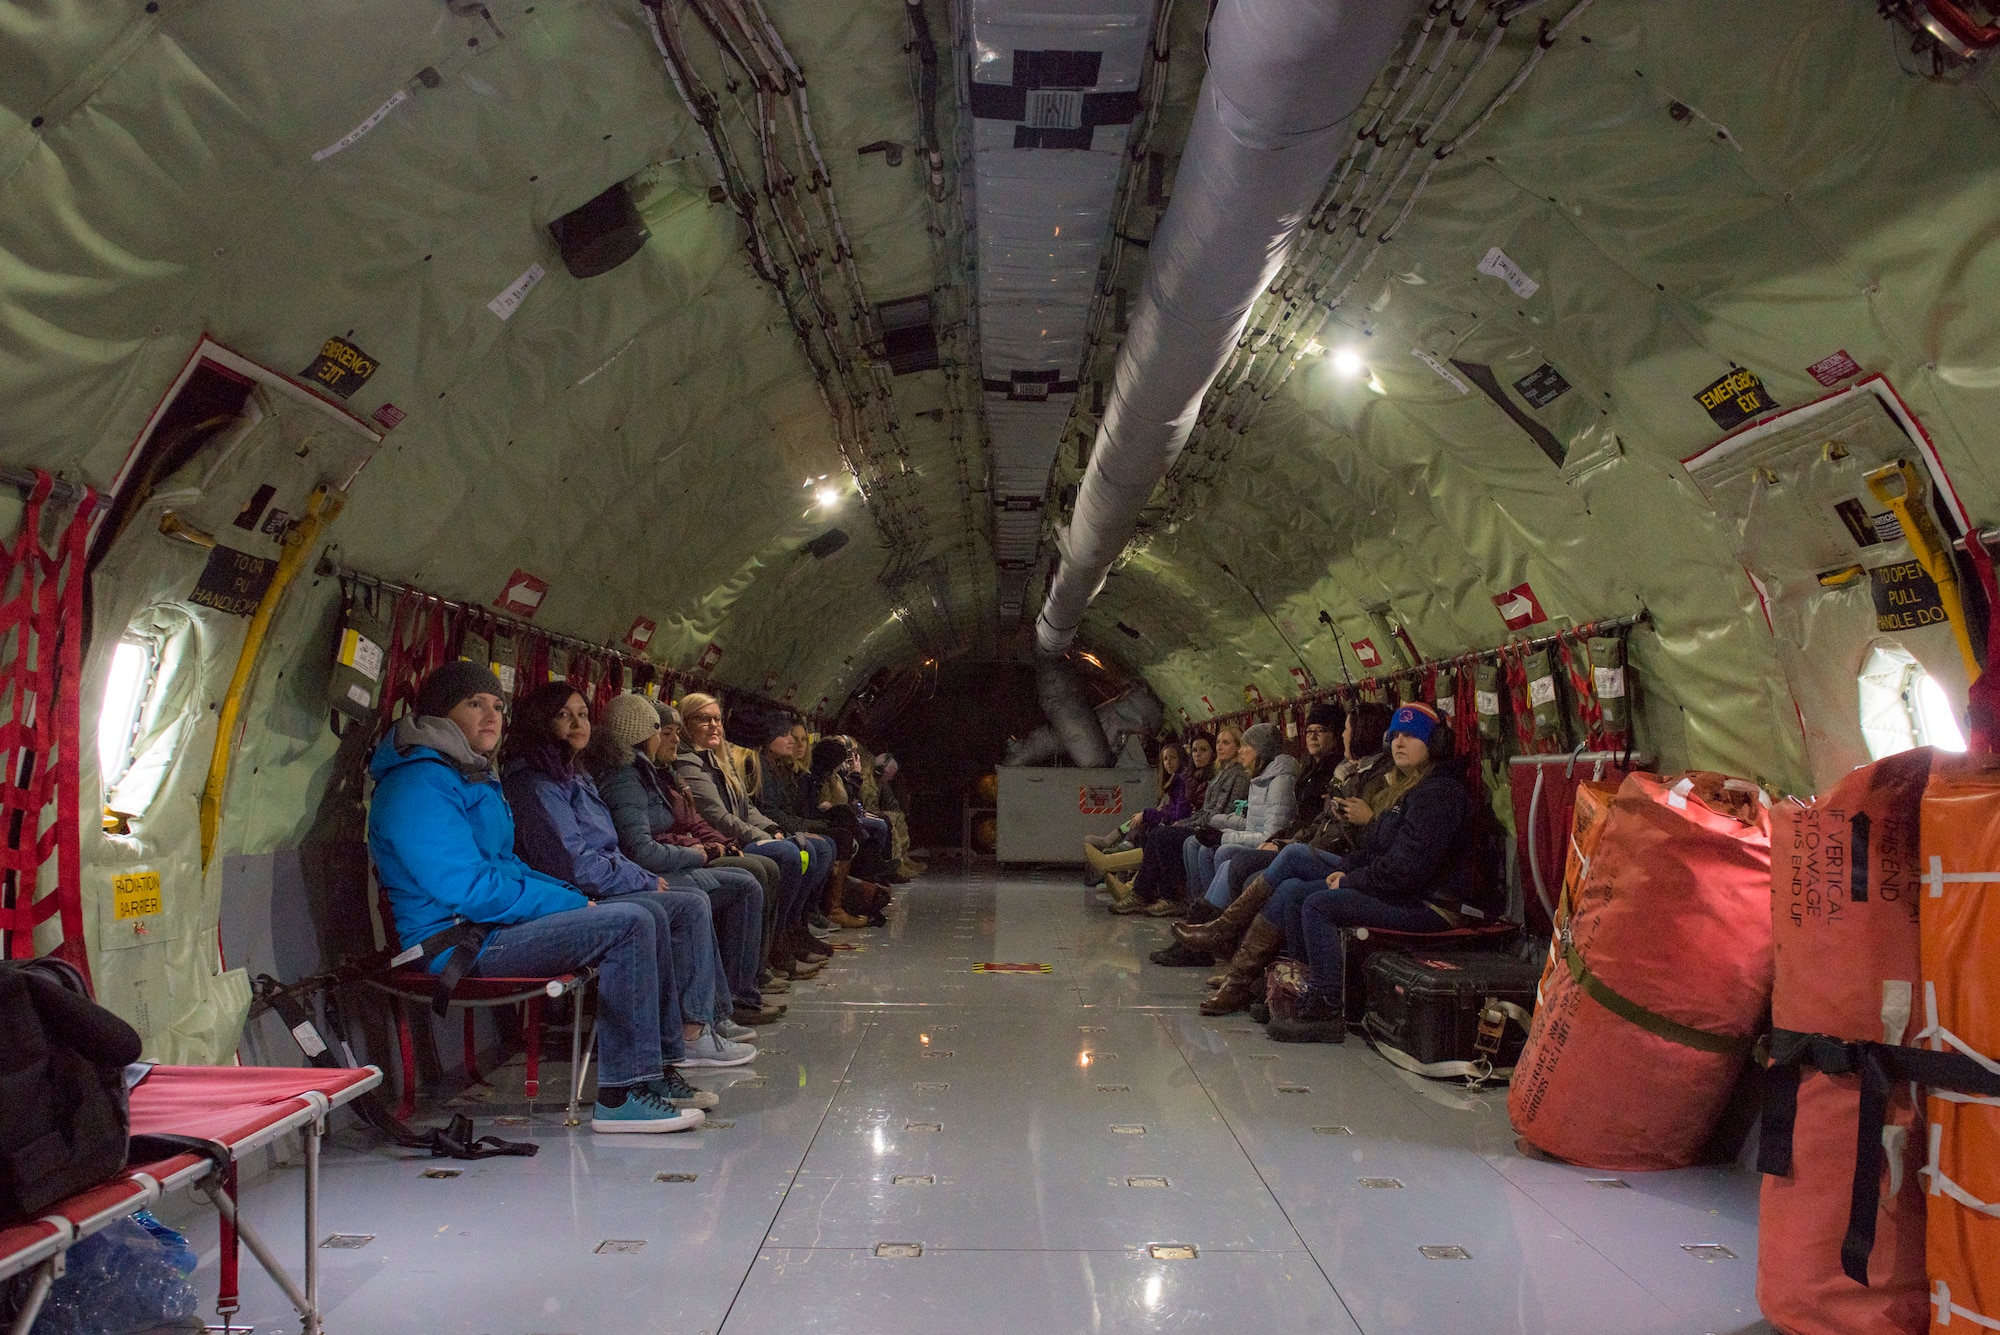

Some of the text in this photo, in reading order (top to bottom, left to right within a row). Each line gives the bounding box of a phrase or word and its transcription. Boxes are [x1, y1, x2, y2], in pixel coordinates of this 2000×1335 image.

[1888, 588, 1922, 605] PULL
[1790, 811, 1803, 927] THIS END UP
[1804, 809, 1821, 917] STOWAGE
[1825, 809, 1845, 925] IF VERTICAL
[1880, 858, 1899, 902] END
